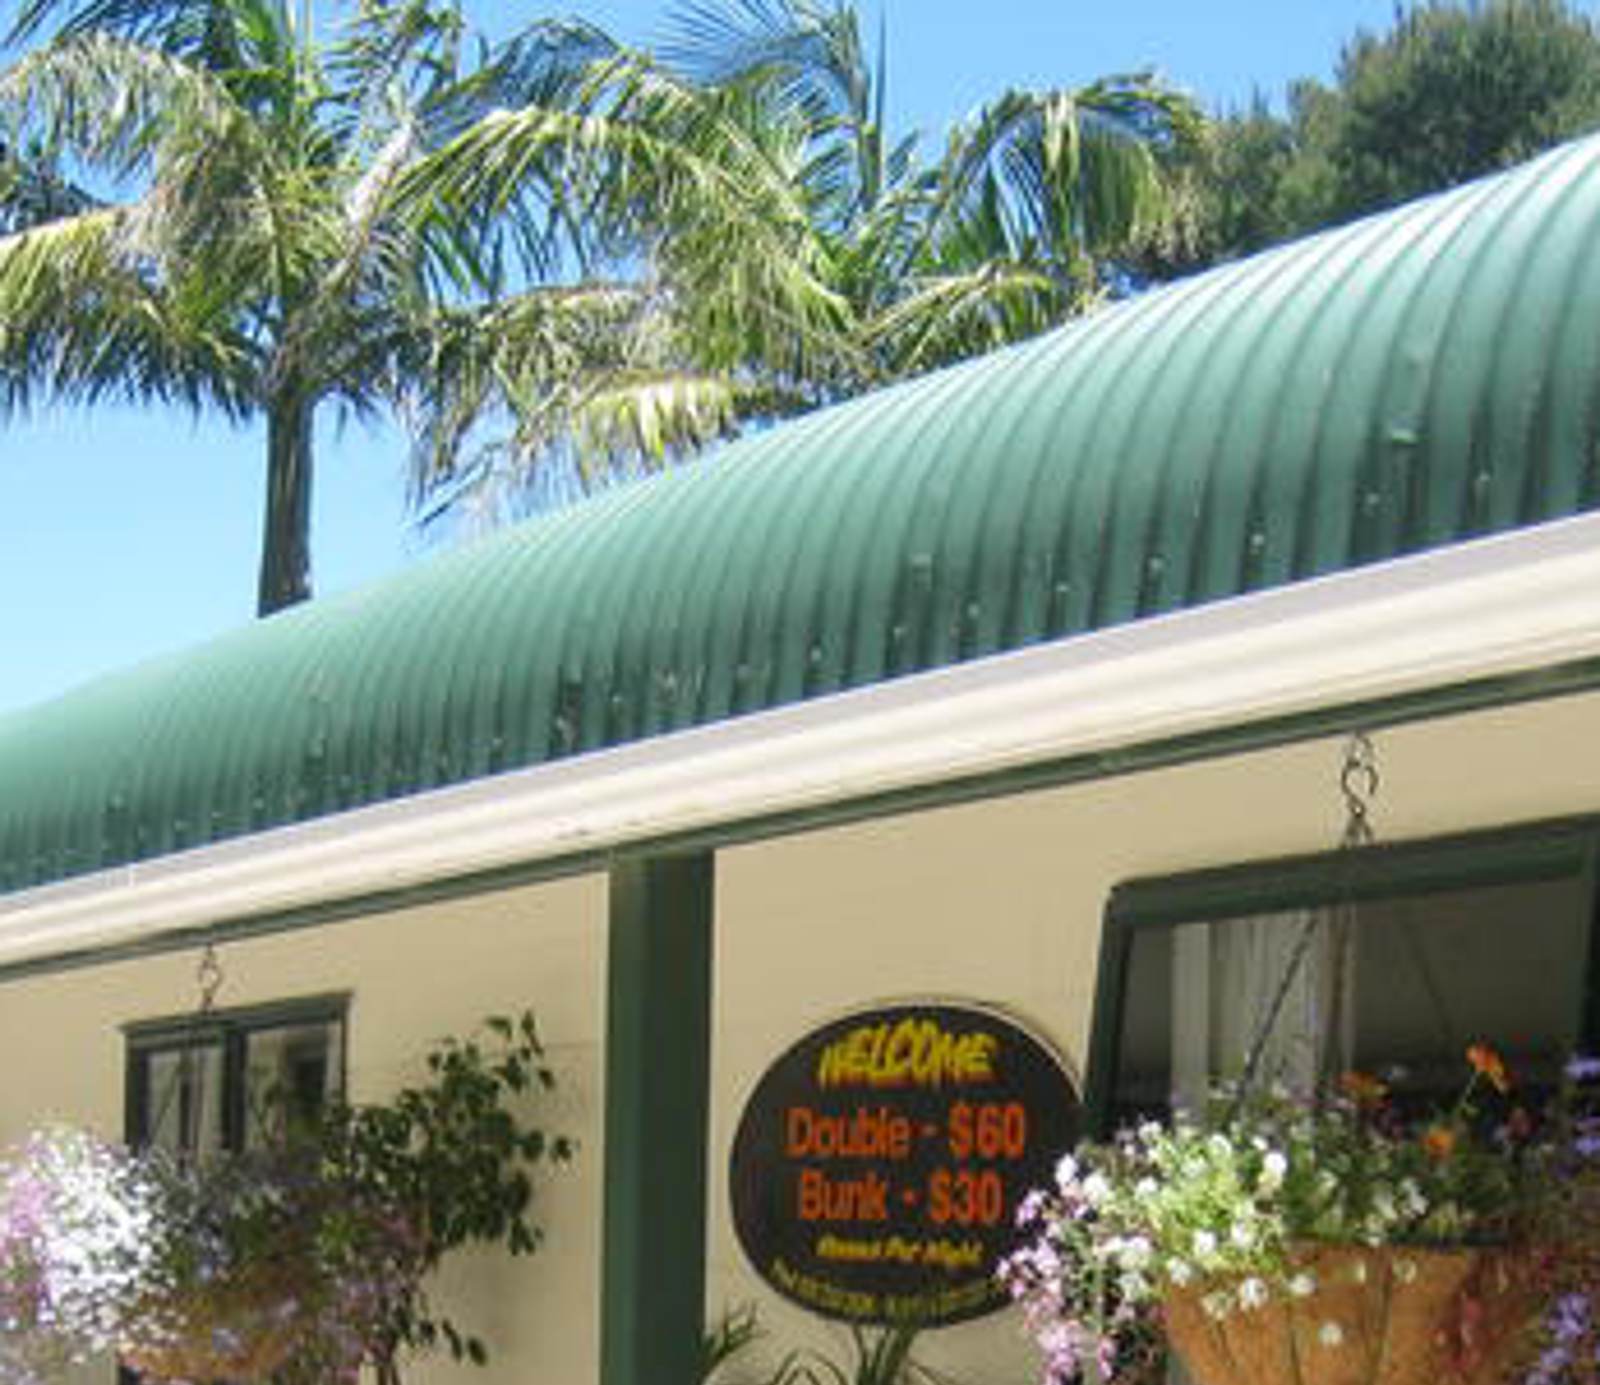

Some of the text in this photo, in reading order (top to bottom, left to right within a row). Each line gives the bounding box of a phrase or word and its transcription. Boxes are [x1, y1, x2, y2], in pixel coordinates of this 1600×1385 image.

[818, 1018, 999, 1087] WELCOME
[785, 1106, 911, 1158] Double
[950, 1101, 1025, 1163] $60
[799, 1168, 887, 1220] Bunk
[928, 1168, 1005, 1224] $30
